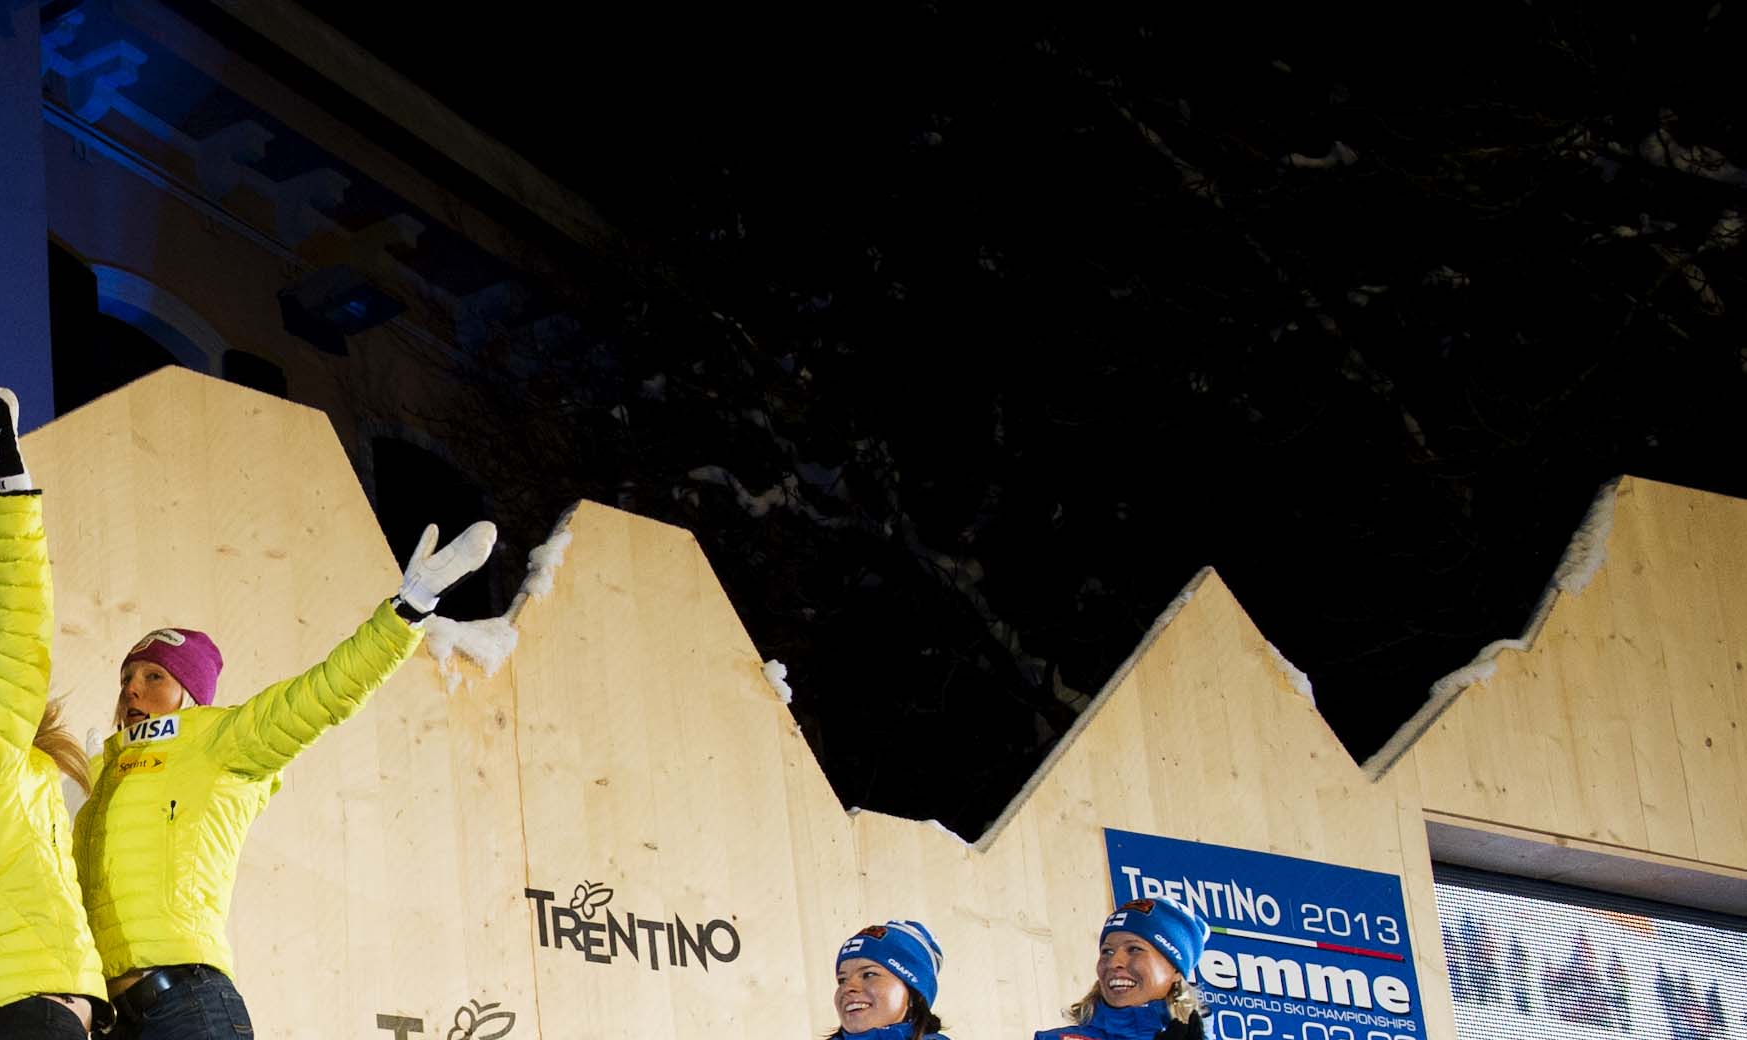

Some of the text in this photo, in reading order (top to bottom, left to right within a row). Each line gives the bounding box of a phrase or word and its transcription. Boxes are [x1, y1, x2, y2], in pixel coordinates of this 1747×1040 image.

[128, 718, 176, 742] VISA
[119, 759, 147, 774] Sprint
[525, 888, 741, 974] TRENTINO
[1300, 904, 1401, 946] 2013
[1154, 934, 1179, 956] CRAFT
[887, 958, 914, 979] CRAFT
[1188, 948, 1411, 1014] emme
[1228, 995, 1281, 1014] WORLD
[1284, 1003, 1304, 1016] SKI
[1306, 1007, 1416, 1032] CHAMPIONSHIPS
